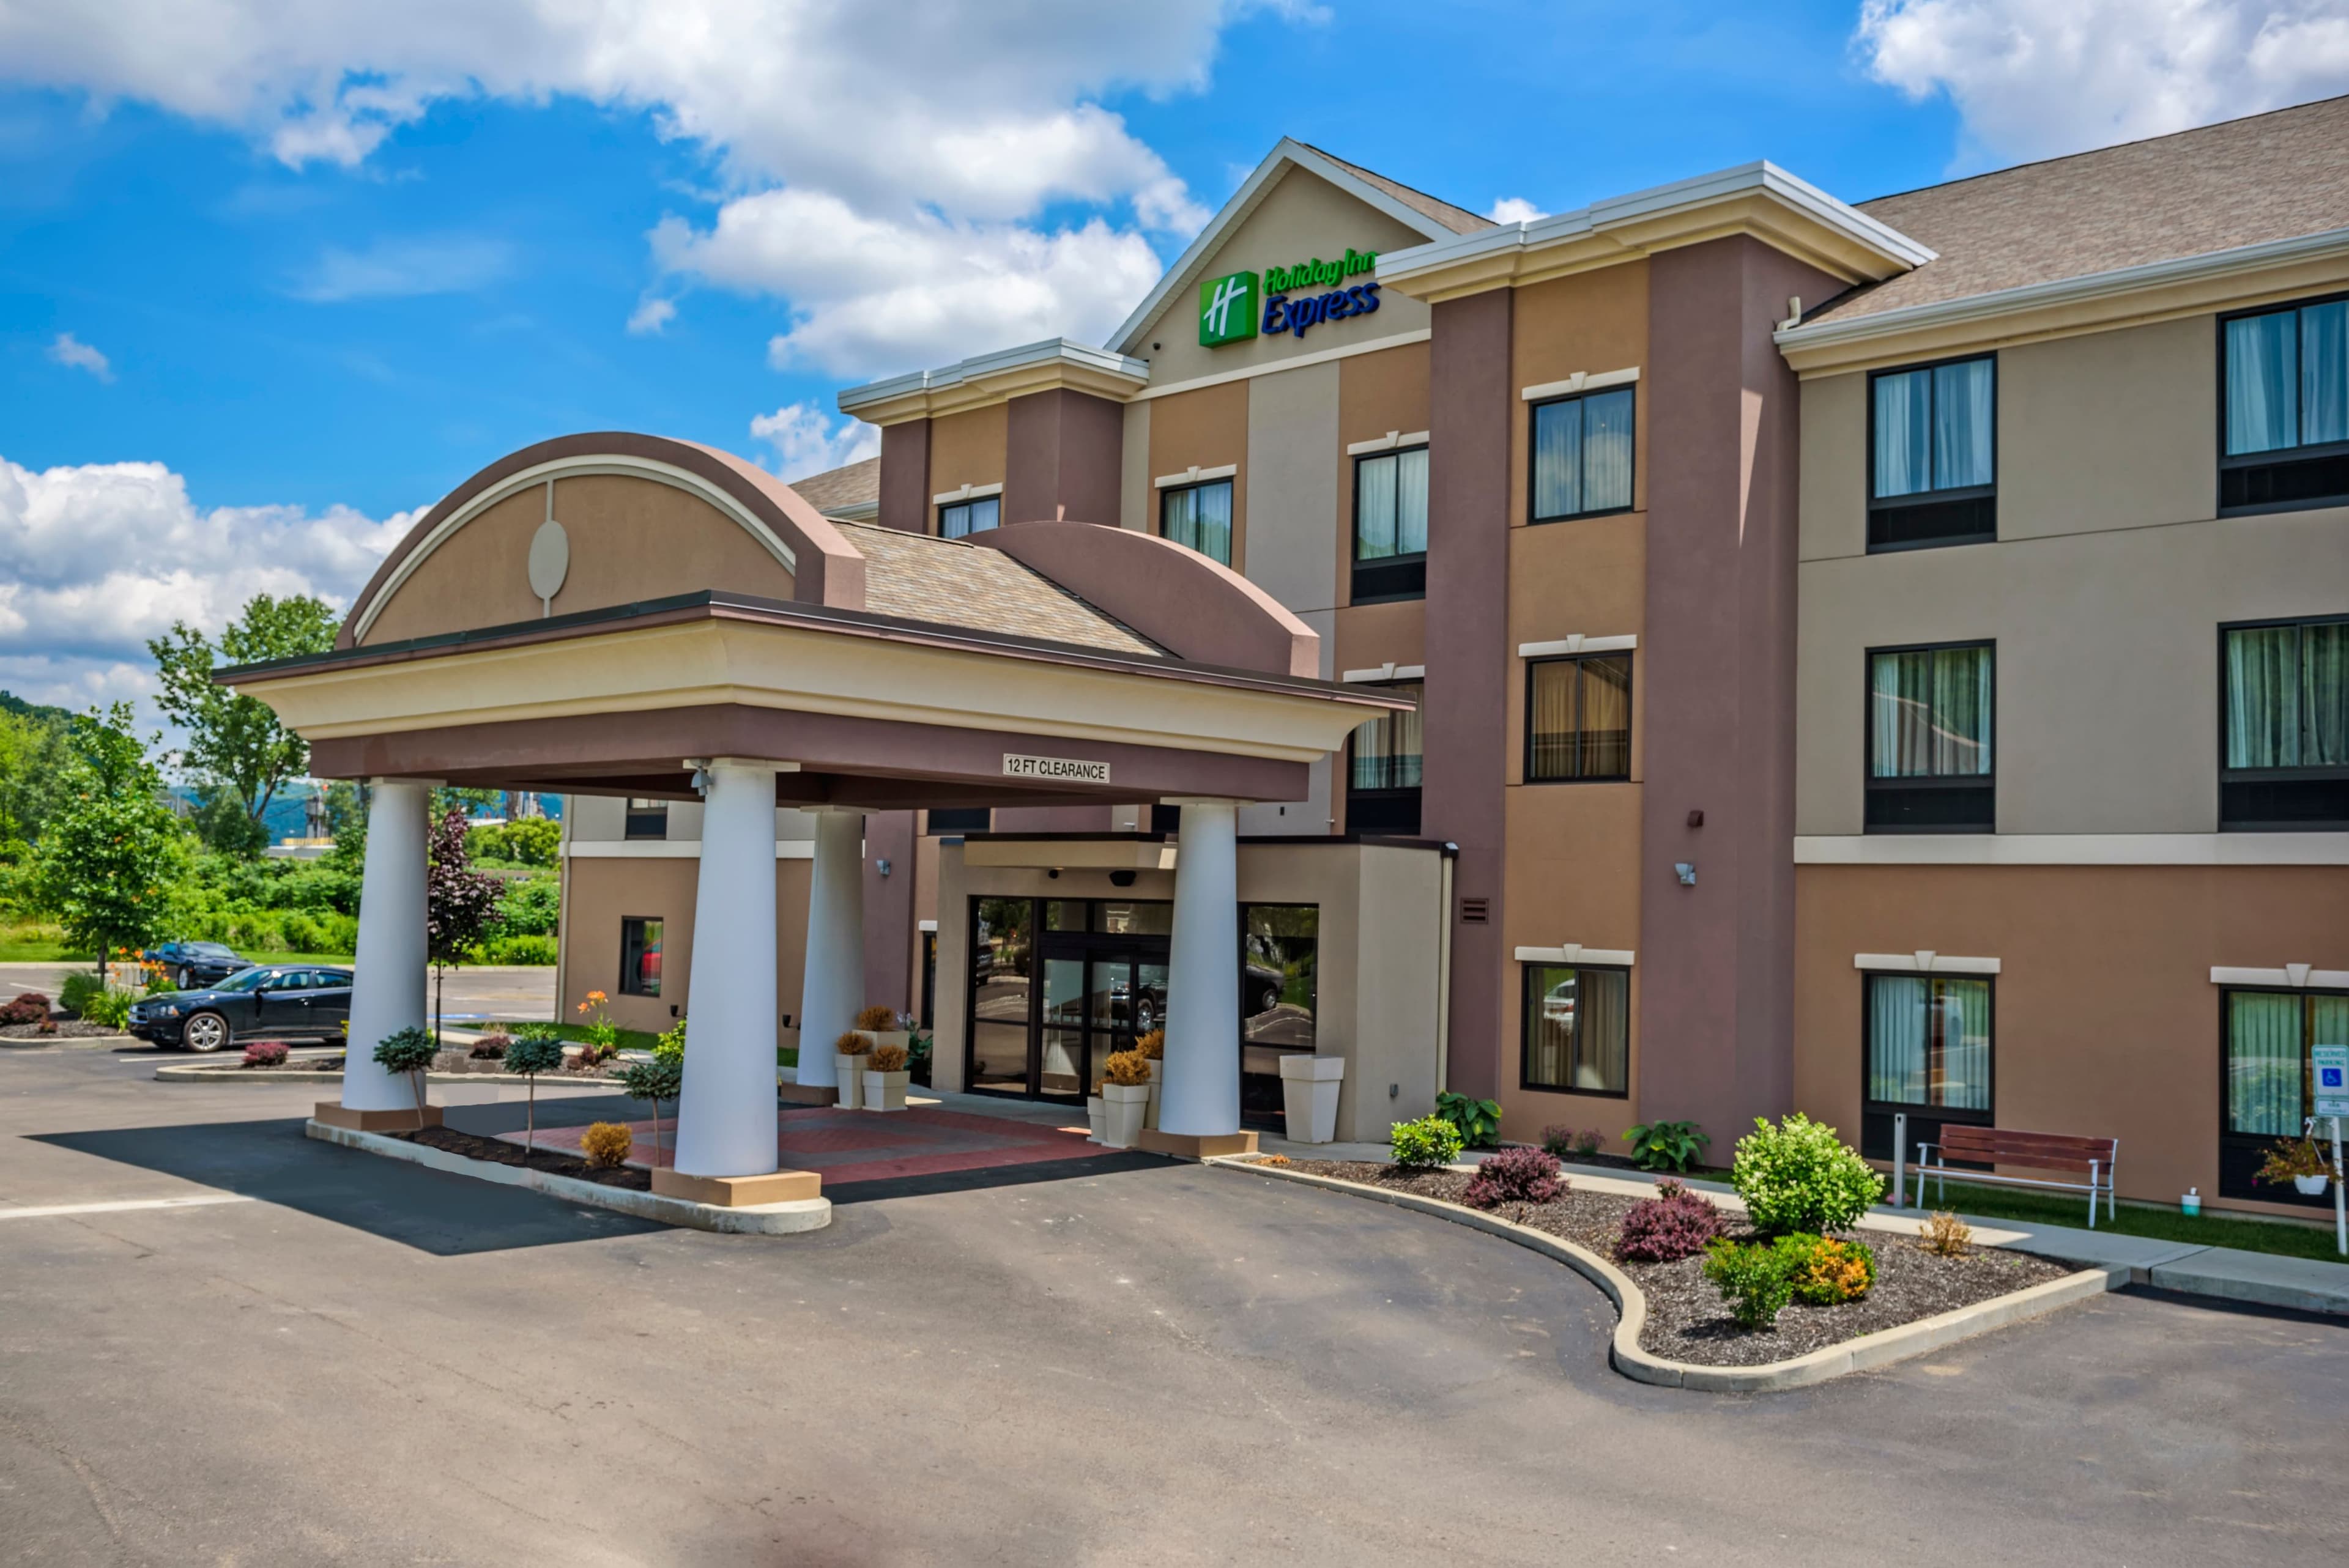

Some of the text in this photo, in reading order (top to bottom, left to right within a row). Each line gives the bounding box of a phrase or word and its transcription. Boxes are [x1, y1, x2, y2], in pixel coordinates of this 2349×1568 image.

[1263, 248, 1379, 295] Holiday Inn
[1261, 283, 1381, 338] Express
[1008, 758, 1105, 779] 12 FT CLEARANCE
